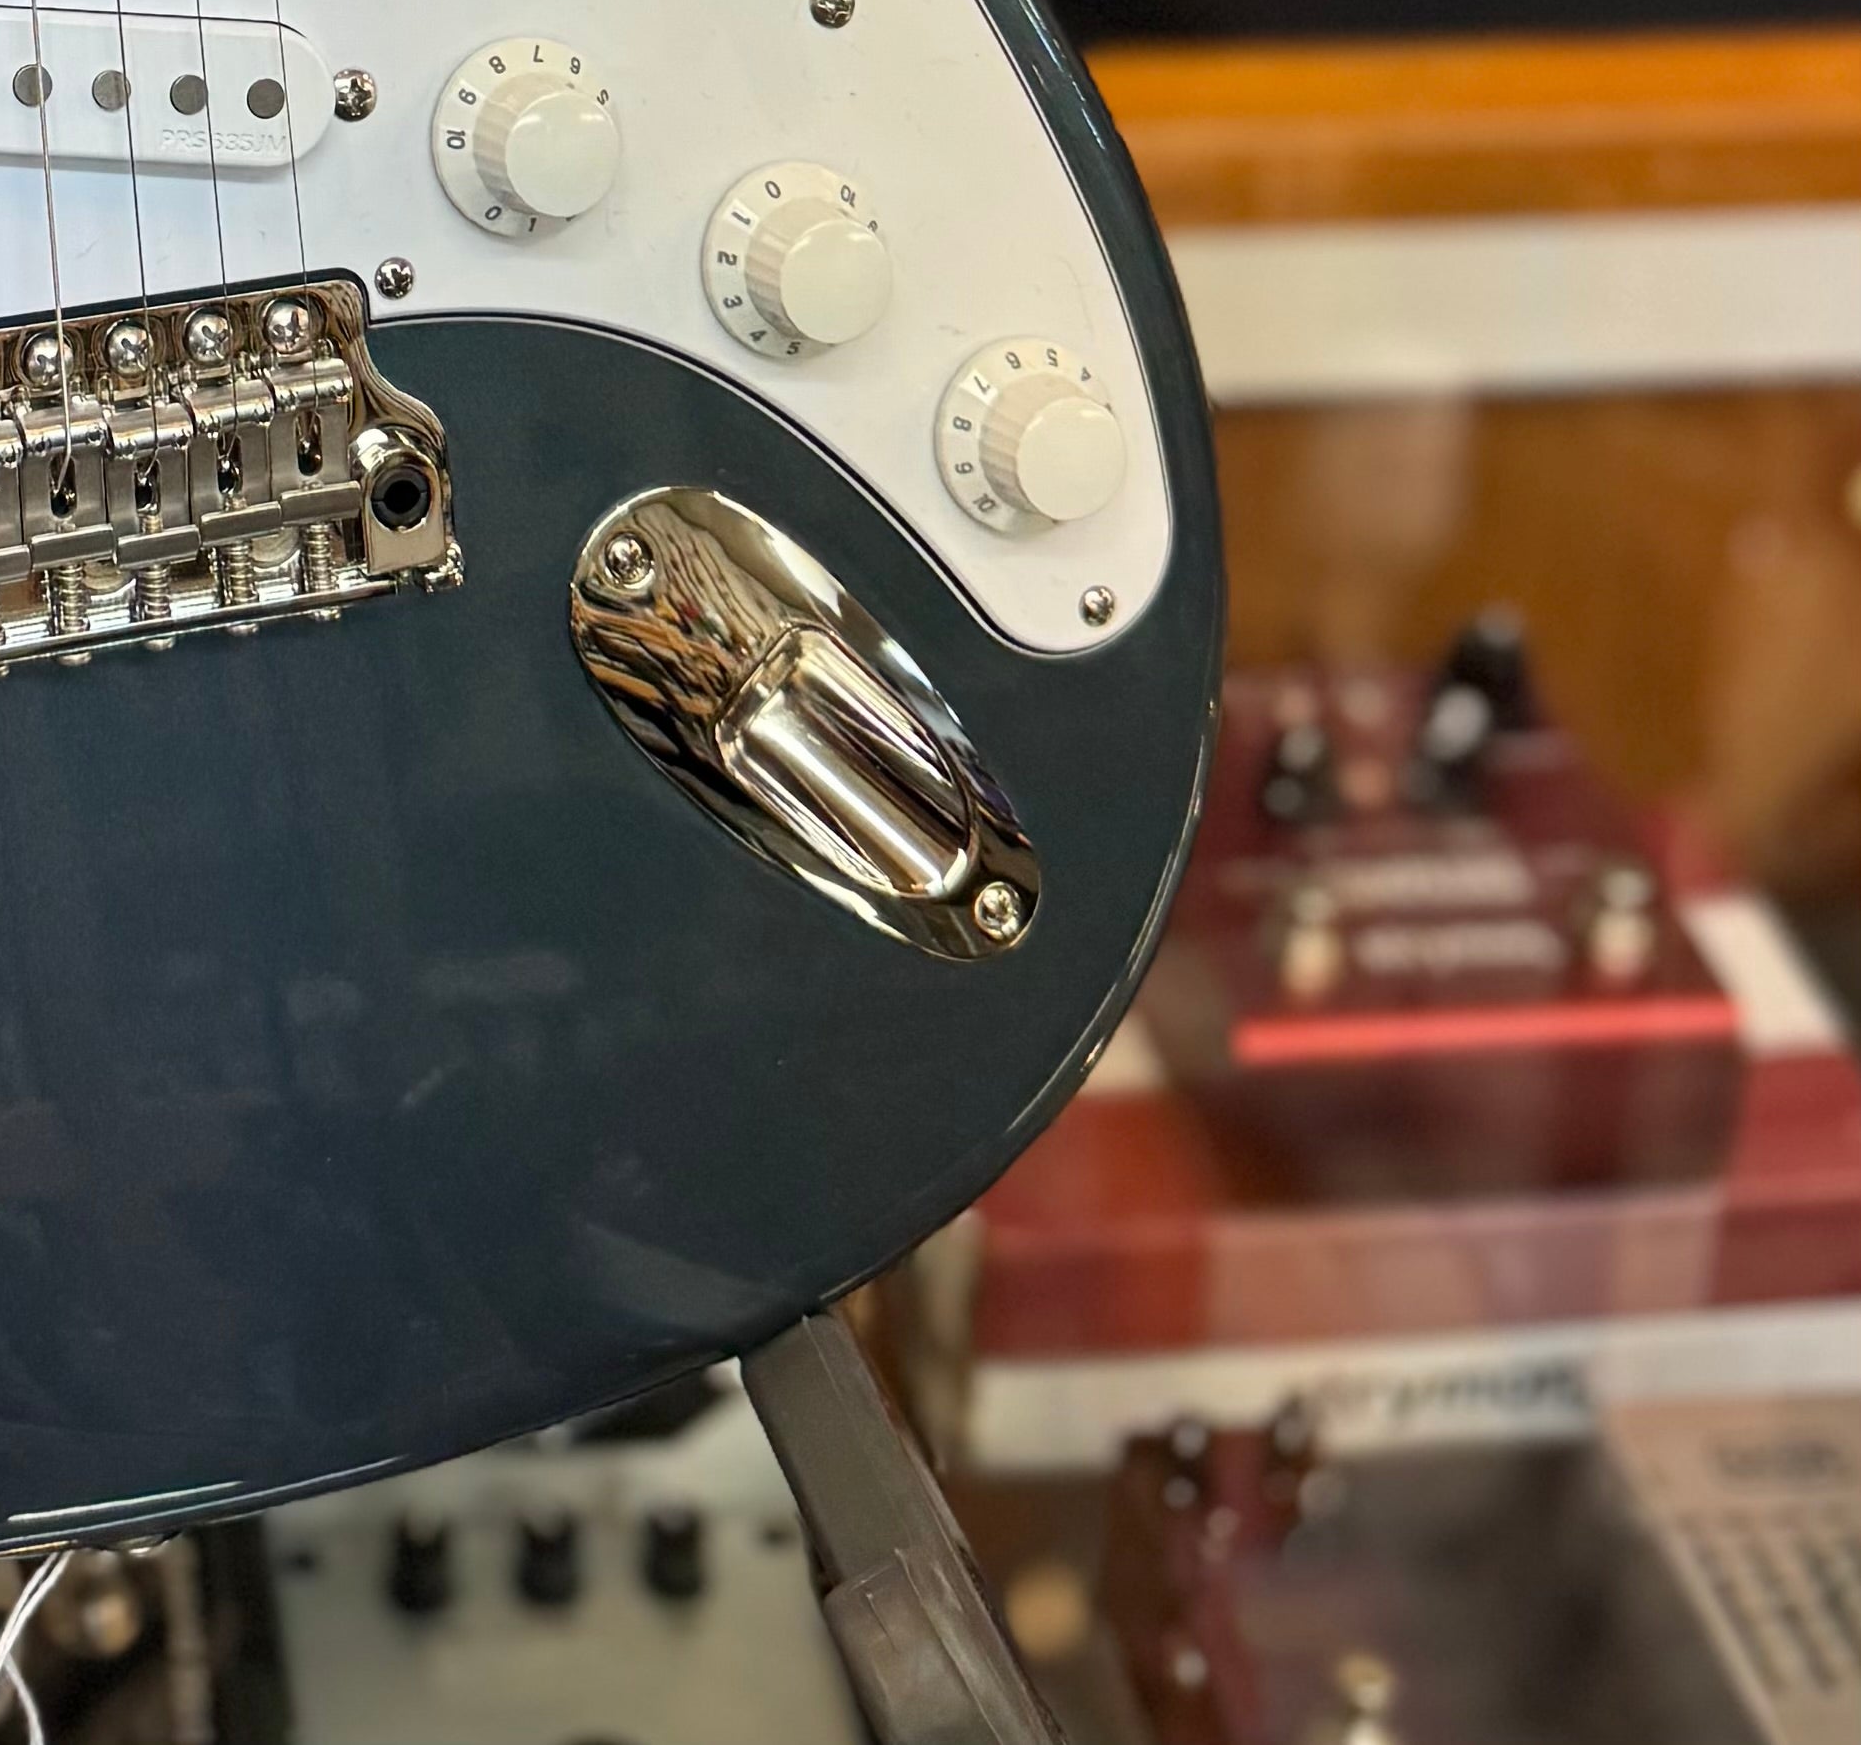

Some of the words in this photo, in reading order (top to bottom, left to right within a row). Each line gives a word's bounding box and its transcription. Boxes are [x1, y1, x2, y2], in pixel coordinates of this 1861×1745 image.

[533, 45, 544, 63] 7
[488, 55, 506, 74] 8
[458, 88, 477, 105] 9
[446, 129, 466, 150] 10
[764, 180, 781, 199] 0
[485, 205, 502, 221] 0
[731, 211, 752, 226] 1
[717, 250, 738, 266] 2
[723, 295, 743, 309] 3
[749, 330, 766, 342] 4
[786, 341, 801, 355] 5
[973, 375, 991, 395] 7
[953, 415, 972, 432] 8
[954, 461, 973, 475] 9
[972, 492, 997, 513] 10
